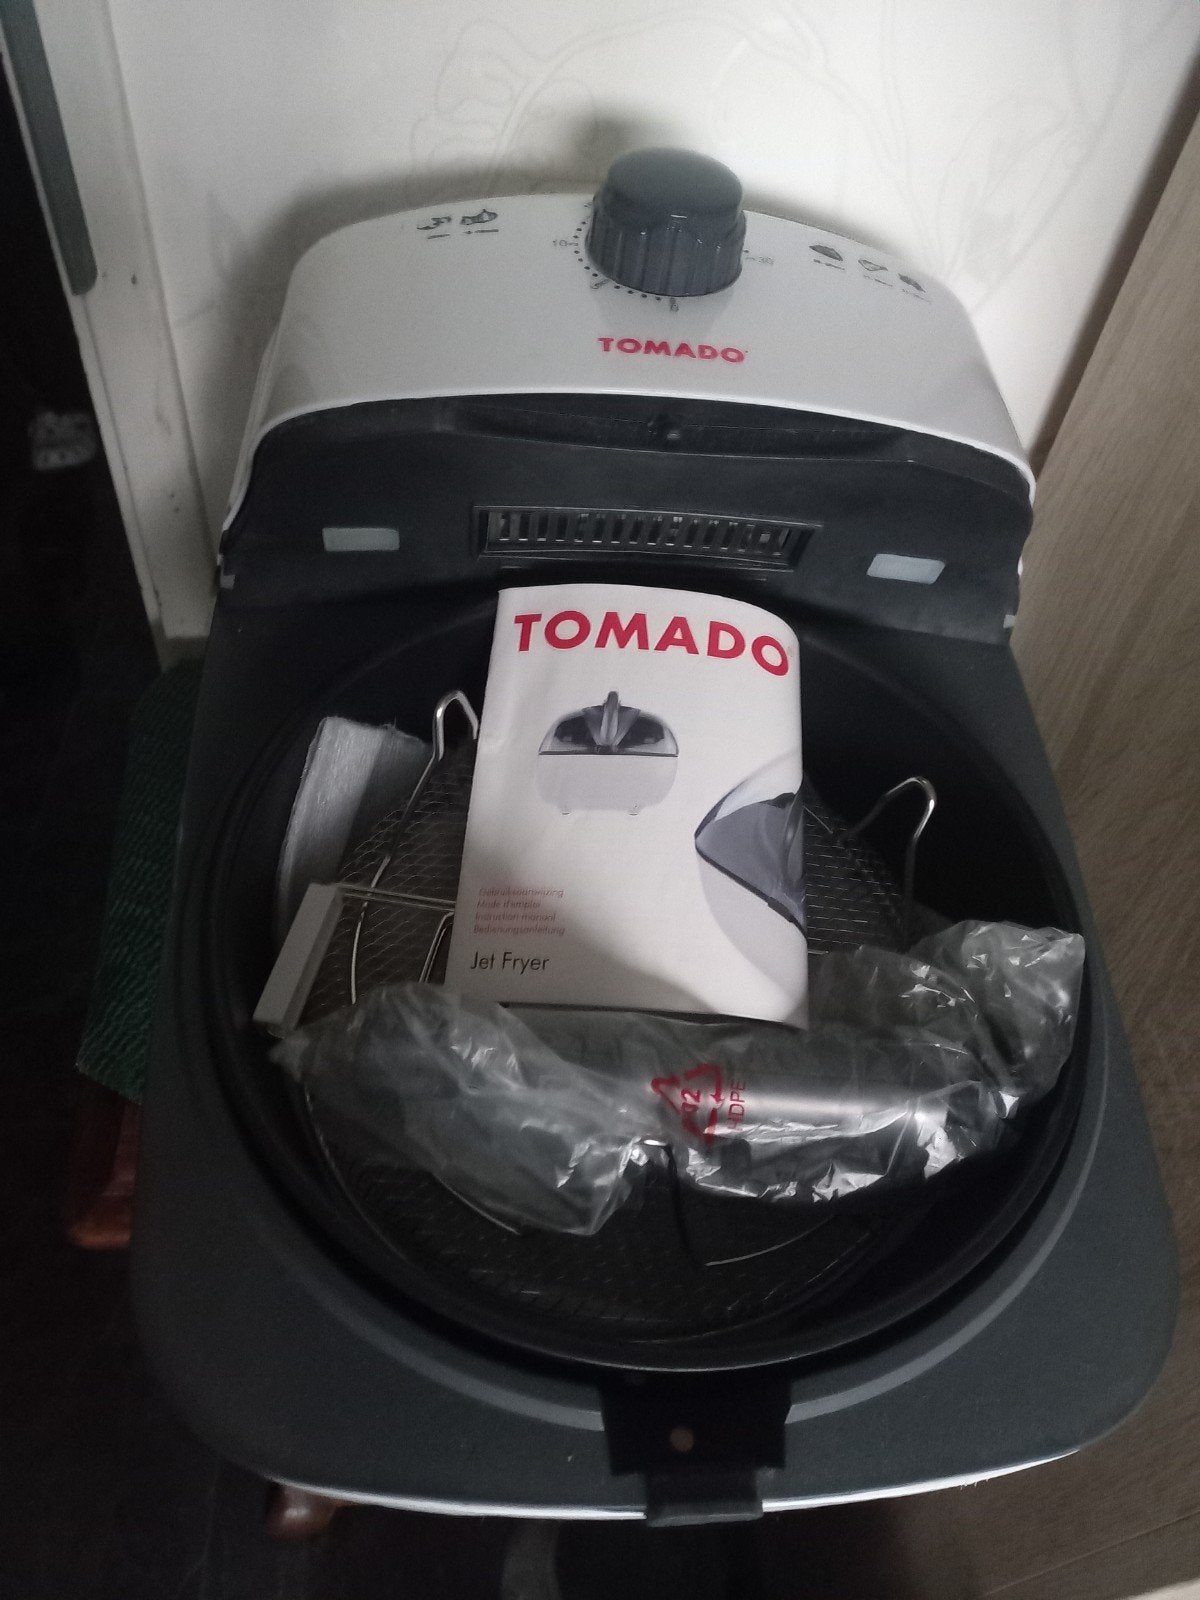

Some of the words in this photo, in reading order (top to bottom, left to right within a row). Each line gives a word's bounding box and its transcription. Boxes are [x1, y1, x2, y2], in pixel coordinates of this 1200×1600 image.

[598, 337, 745, 363] TOMADO
[514, 610, 789, 676] TOMADO
[475, 911, 519, 921] Instruction
[521, 911, 556, 921] manual
[470, 951, 495, 970] Jet
[502, 951, 550, 975] Fryer
